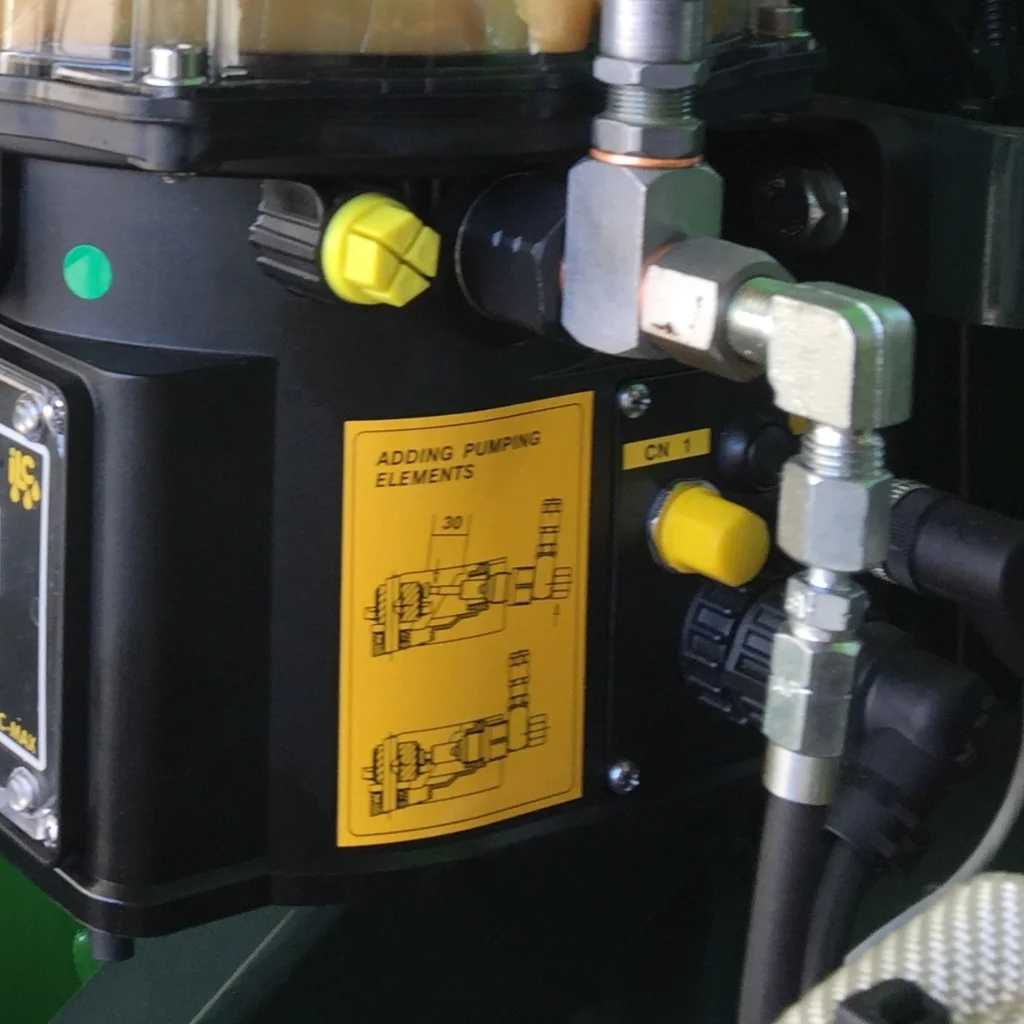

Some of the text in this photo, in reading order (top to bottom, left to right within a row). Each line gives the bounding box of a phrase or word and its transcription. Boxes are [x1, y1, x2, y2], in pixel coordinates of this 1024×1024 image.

[376, 430, 542, 466] ADDING PUMPING
[644, 437, 691, 460] CN 1
[375, 464, 475, 487] ELEMENTS
[442, 515, 463, 529] 30
